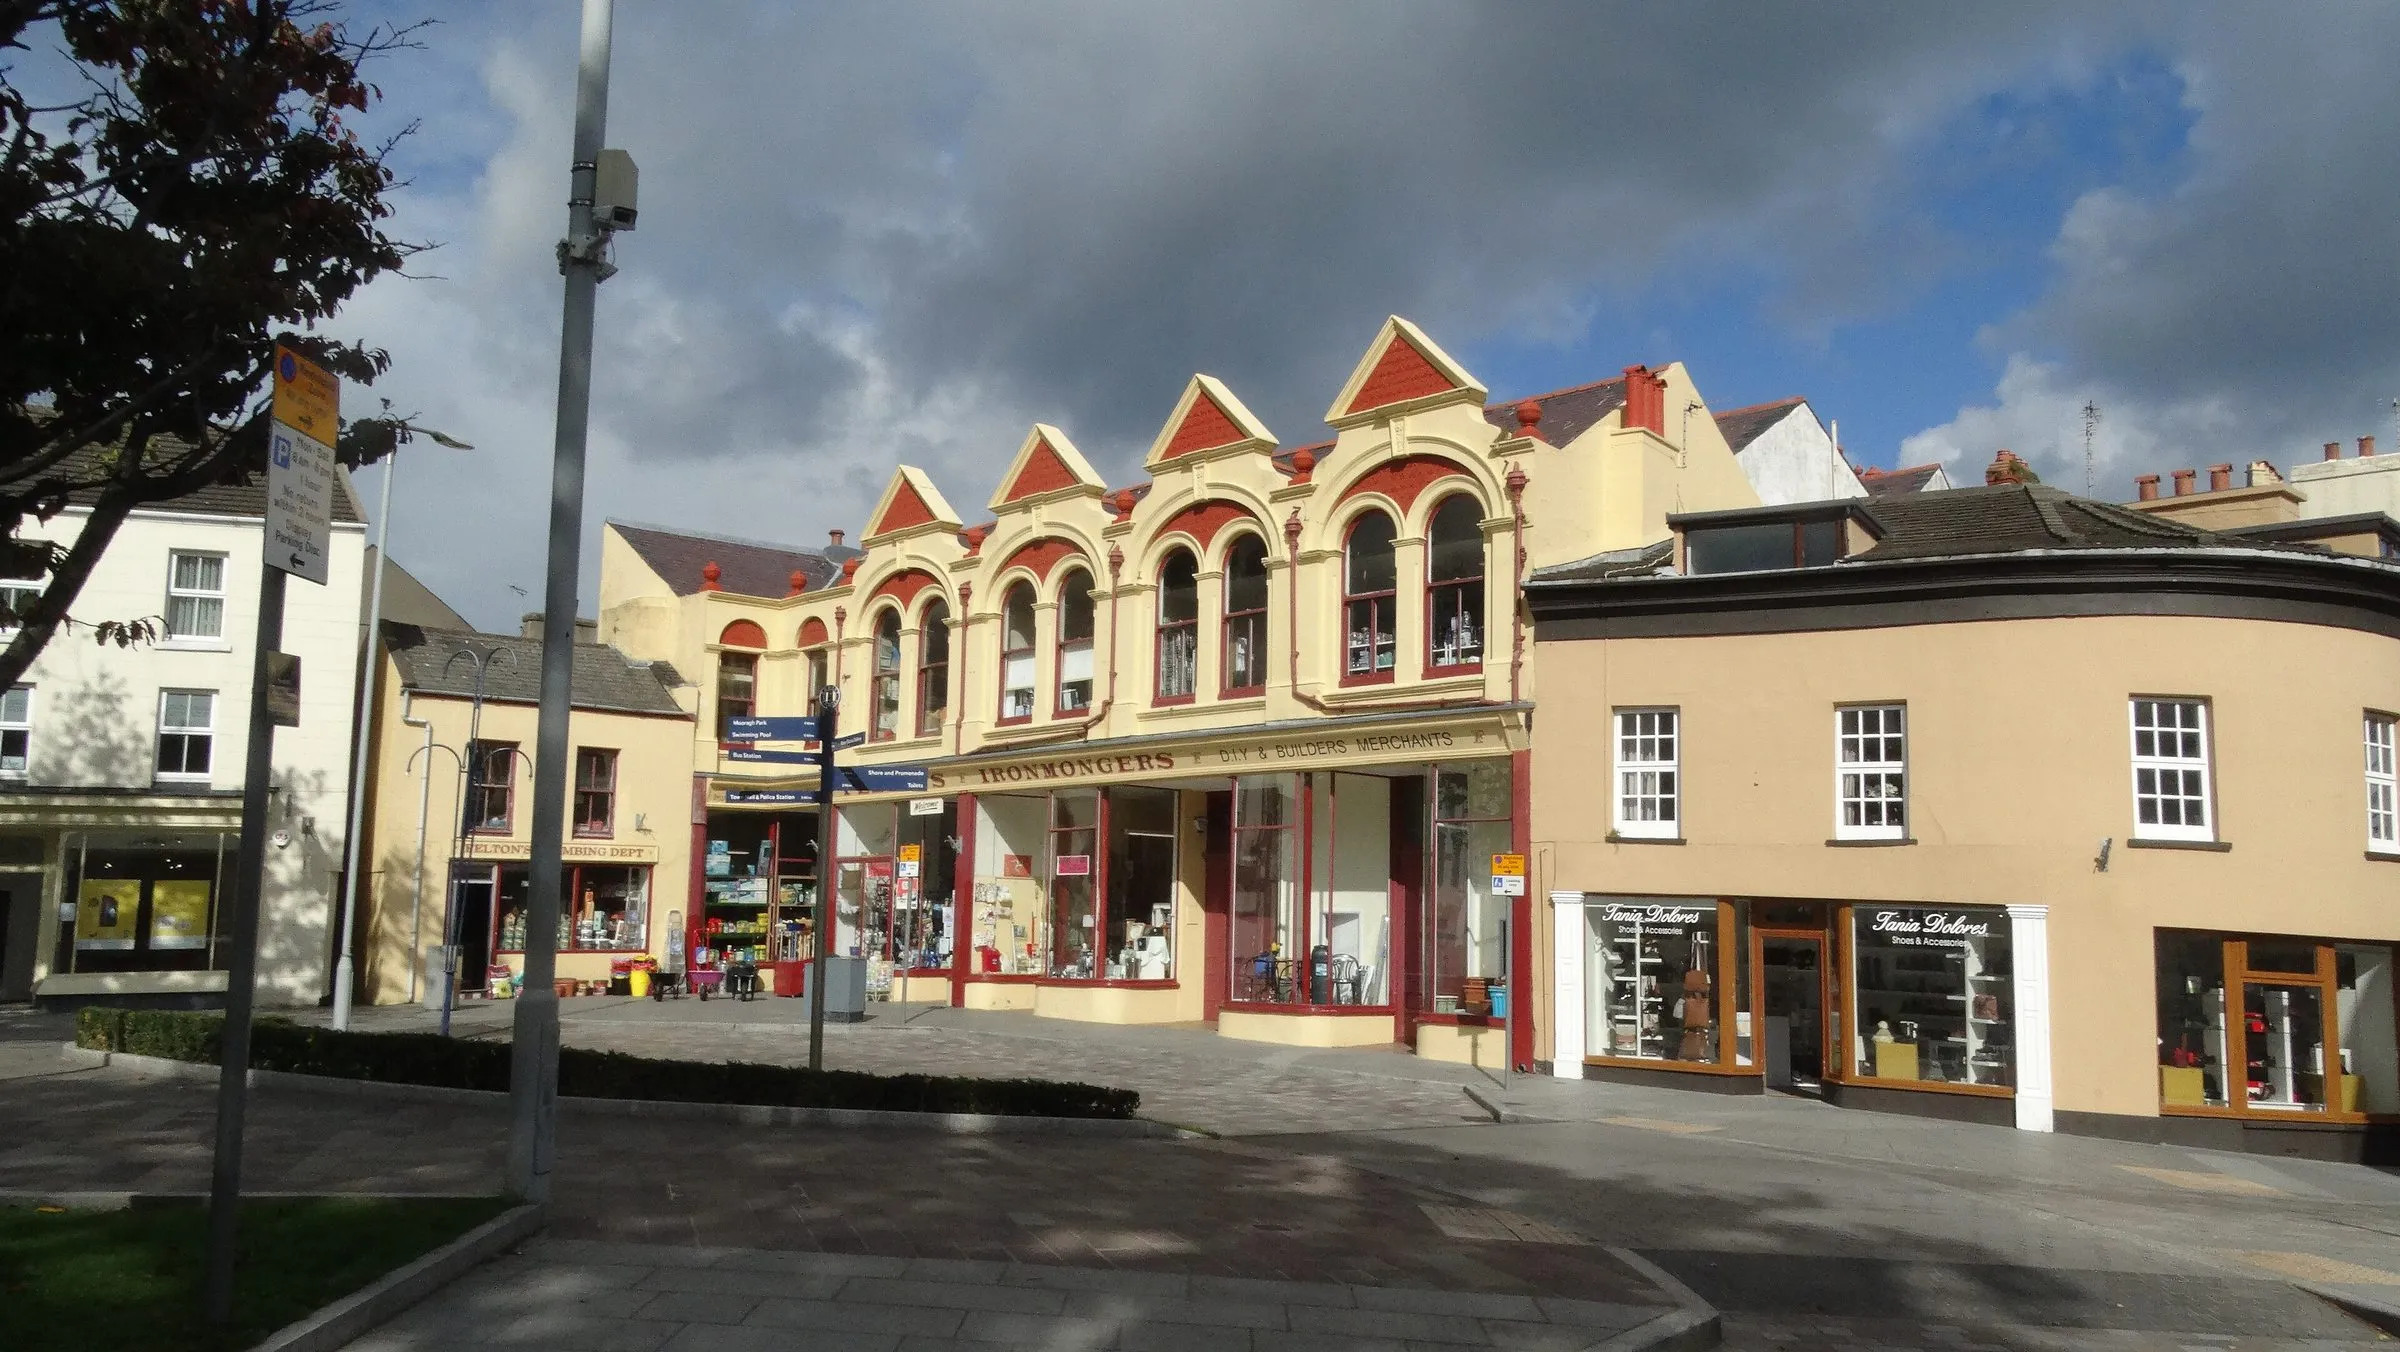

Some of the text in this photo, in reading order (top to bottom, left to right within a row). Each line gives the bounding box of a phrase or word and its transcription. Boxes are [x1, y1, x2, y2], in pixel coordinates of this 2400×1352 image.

[285, 517, 313, 541] Display
[275, 529, 321, 557] Parking Disc
[1258, 746, 1268, 759] &
[1275, 739, 1347, 759] BUILDERS
[1356, 731, 1454, 752] MERCHANTS
[895, 769, 924, 777] Promenade
[978, 751, 1176, 784] IRONMONGERS
[914, 800, 939, 811] Welcome
[465, 842, 531, 855] FELTON'S
[610, 847, 644, 858] DEPT
[1602, 903, 1700, 924] Tania Dolores
[1872, 911, 1988, 935] Tania Dolores
[1618, 925, 1683, 935] Shoes & Accessories
[1891, 935, 1970, 948] Shoes & Accessories
